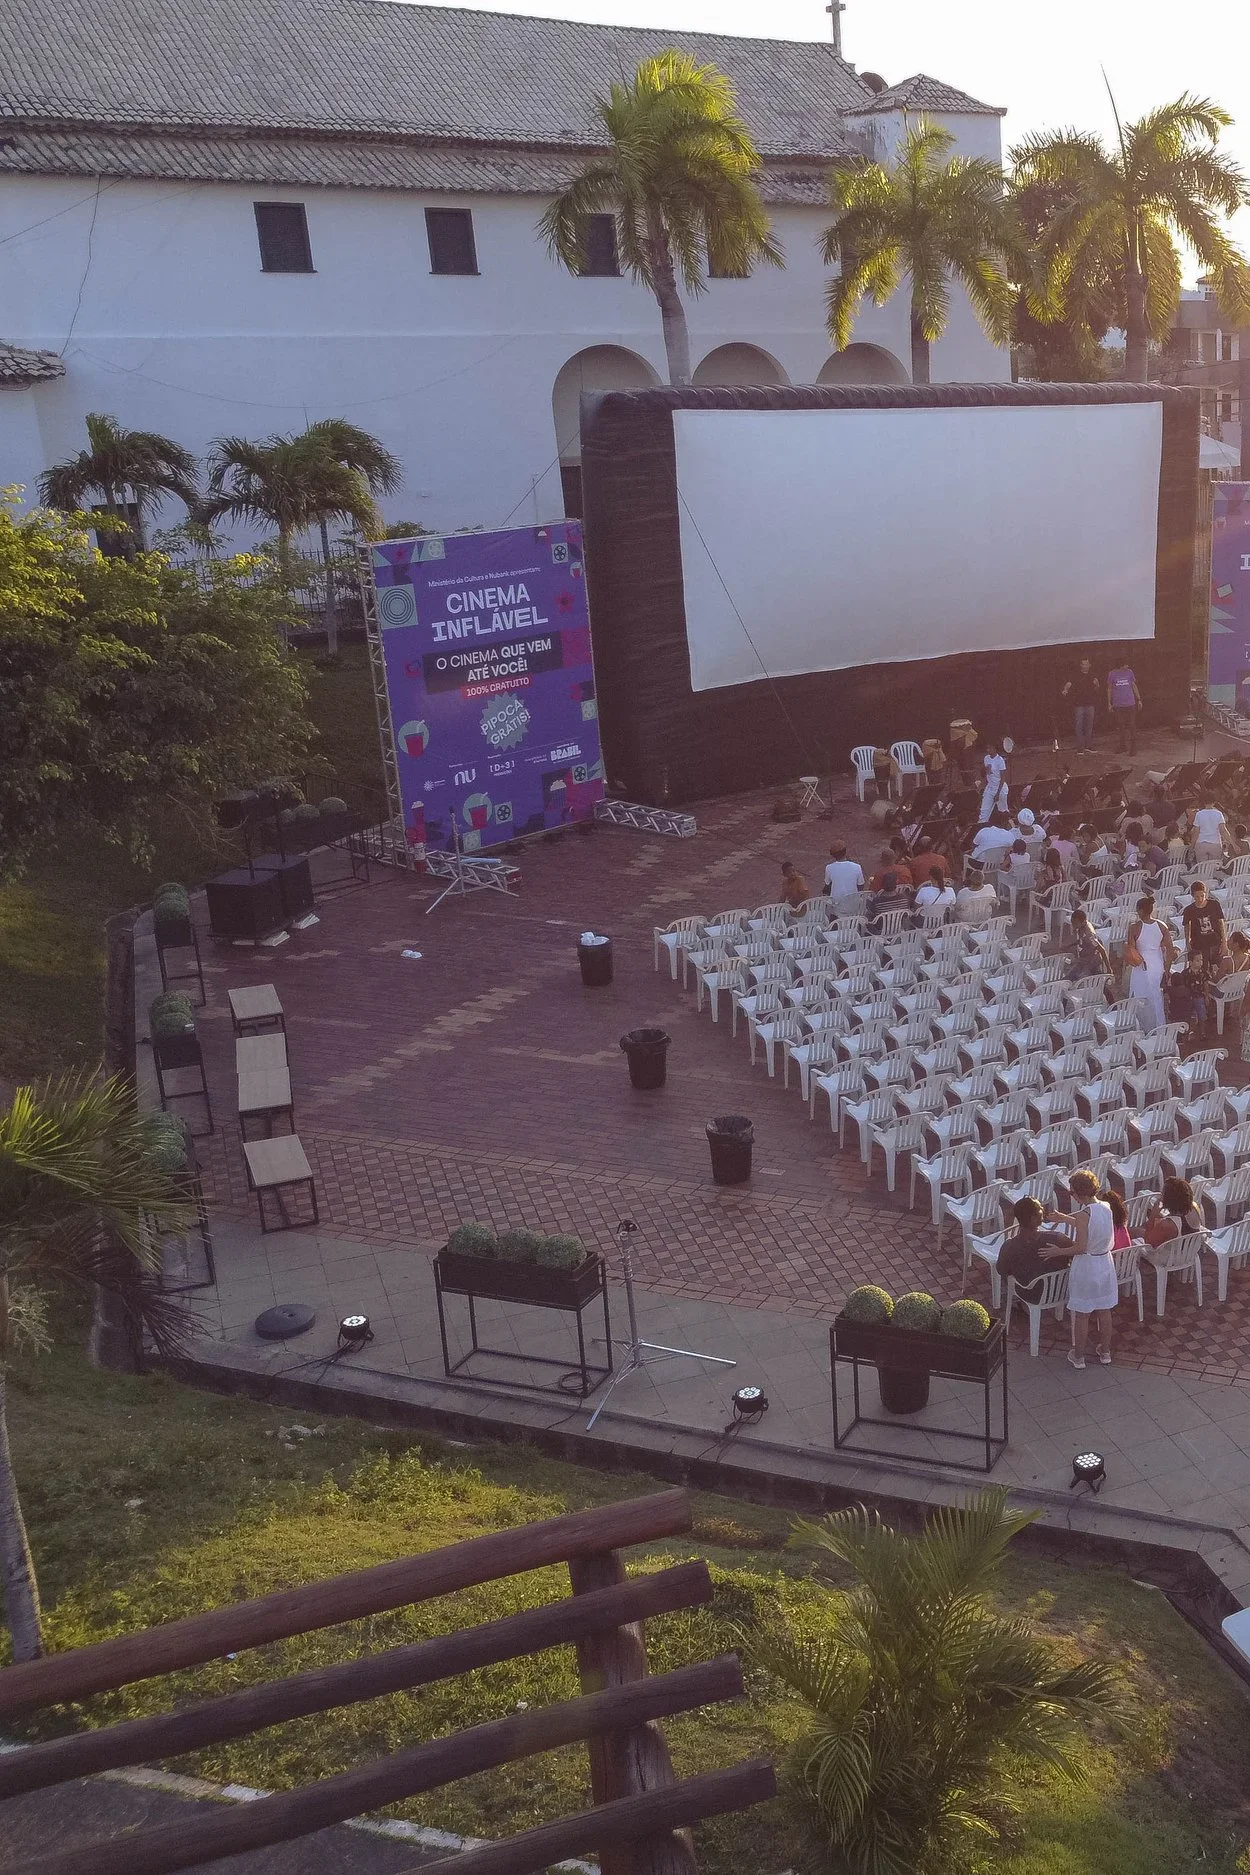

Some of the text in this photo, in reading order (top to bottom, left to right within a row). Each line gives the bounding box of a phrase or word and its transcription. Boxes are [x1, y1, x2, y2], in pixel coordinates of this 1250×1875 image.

[428, 578, 456, 588] Ministério
[464, 574, 484, 583] Cultura
[489, 570, 510, 579] Nubank
[446, 583, 531, 614] CINEMA
[431, 606, 549, 642] INFLÁVEL
[436, 638, 552, 670] O CINEMA QUE VEM
[467, 658, 528, 682] ATÉ VOCÊ!
[466, 677, 530, 696] 100% GRATUITO
[480, 699, 524, 736] PIPOCA
[490, 710, 532, 745] GRÁTIS!
[550, 744, 582, 762] BRASIL
